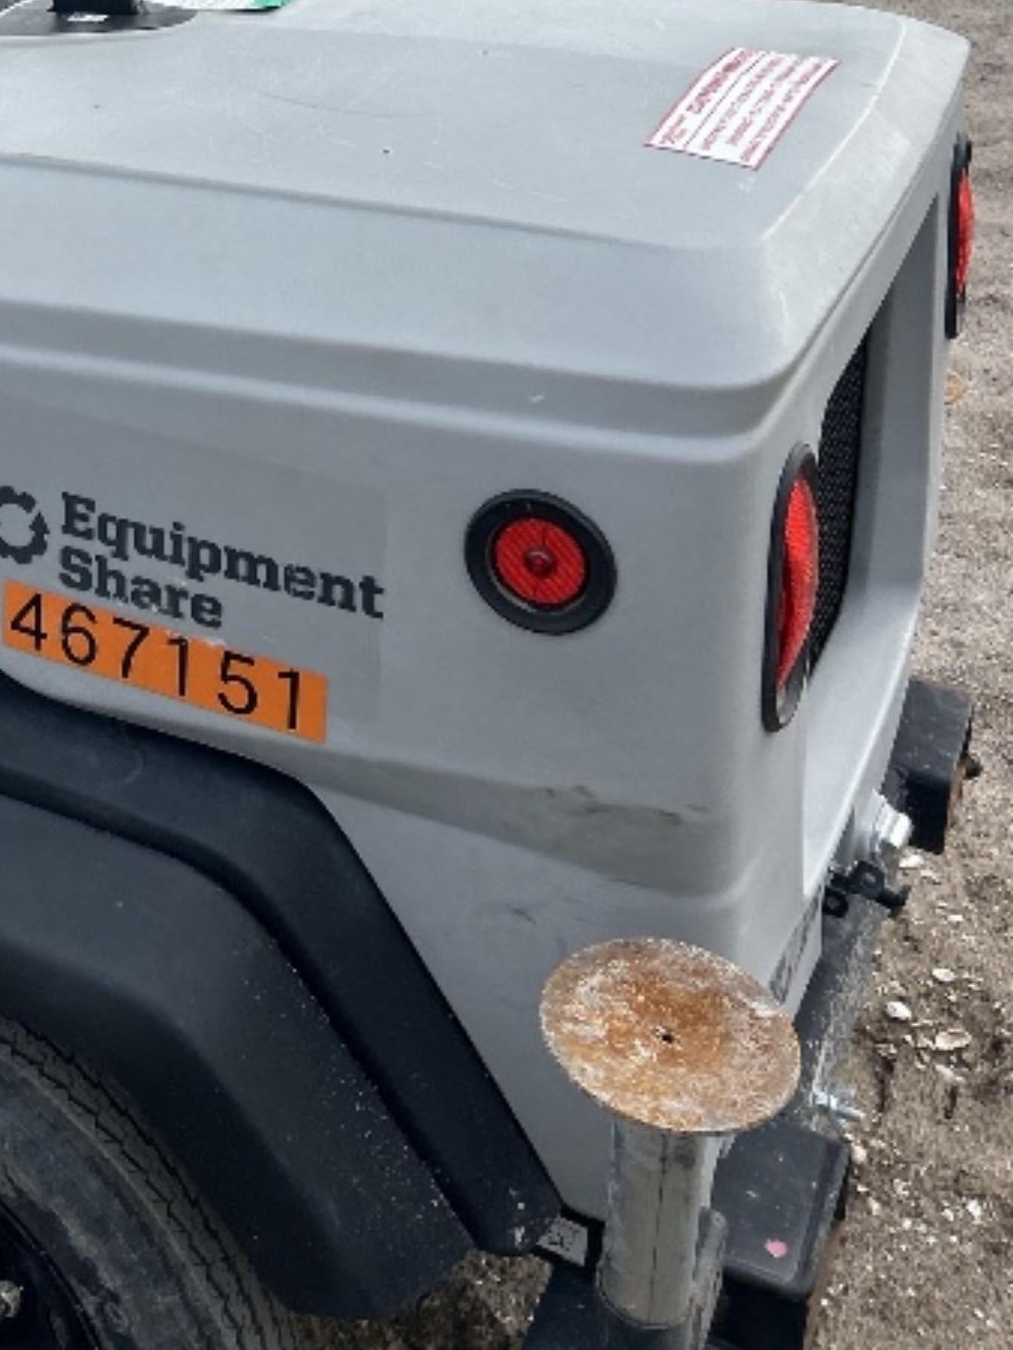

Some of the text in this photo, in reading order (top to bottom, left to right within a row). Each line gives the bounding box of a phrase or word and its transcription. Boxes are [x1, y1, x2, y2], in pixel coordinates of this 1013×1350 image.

[58, 545, 223, 628] Share
[61, 491, 384, 619] Equipment
[10, 593, 300, 730] 467151
